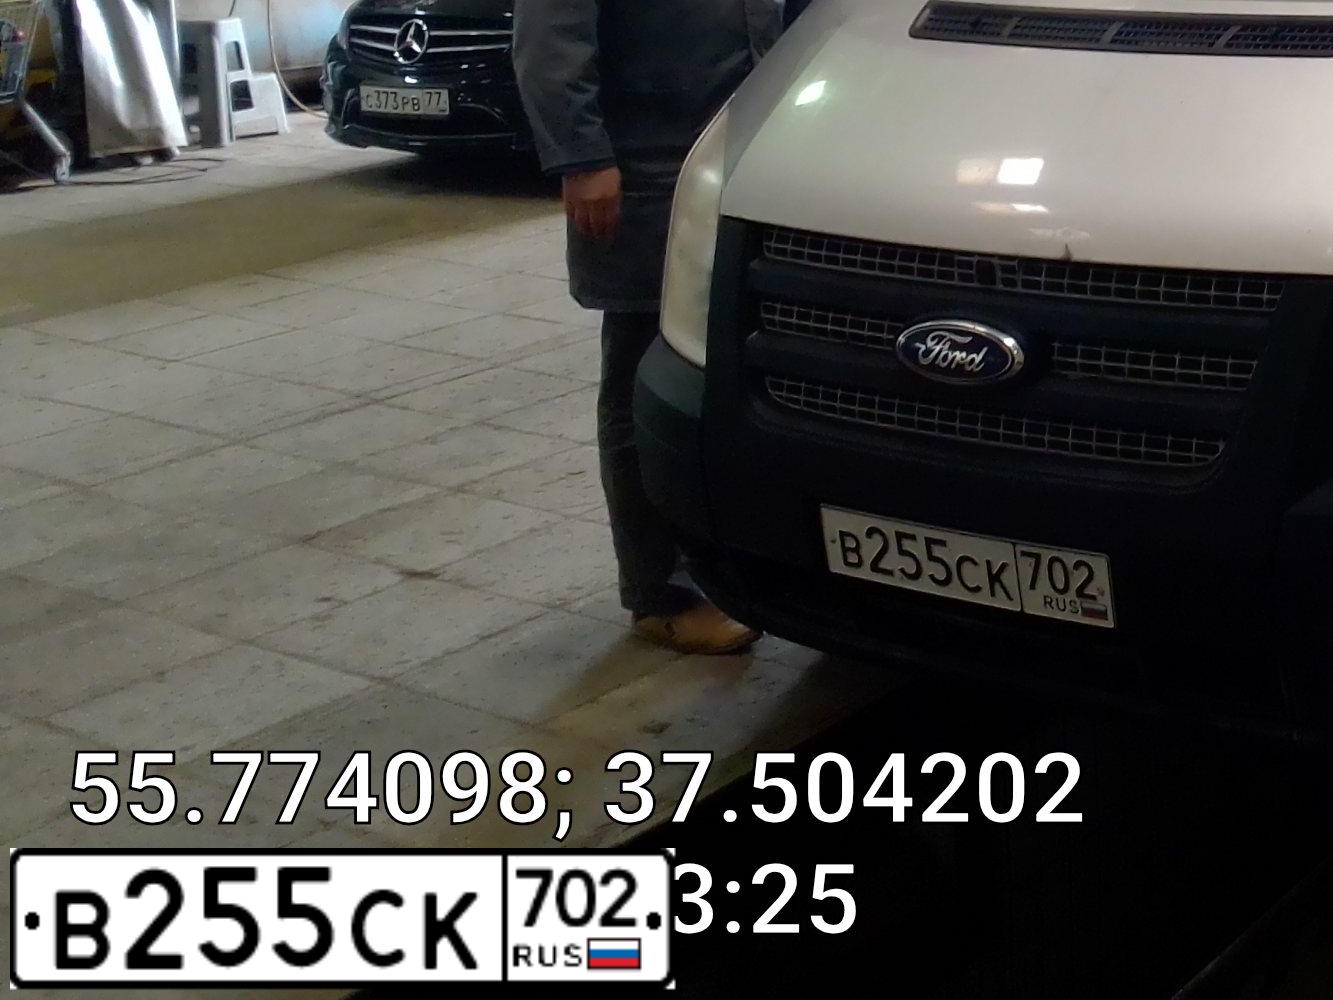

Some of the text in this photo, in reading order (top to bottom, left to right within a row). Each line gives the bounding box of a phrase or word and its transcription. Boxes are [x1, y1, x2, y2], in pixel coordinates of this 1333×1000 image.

[425, 91, 441, 106] 77
[914, 331, 988, 372] Ford
[1020, 551, 1097, 600] 702
[1043, 594, 1080, 614] RUS
